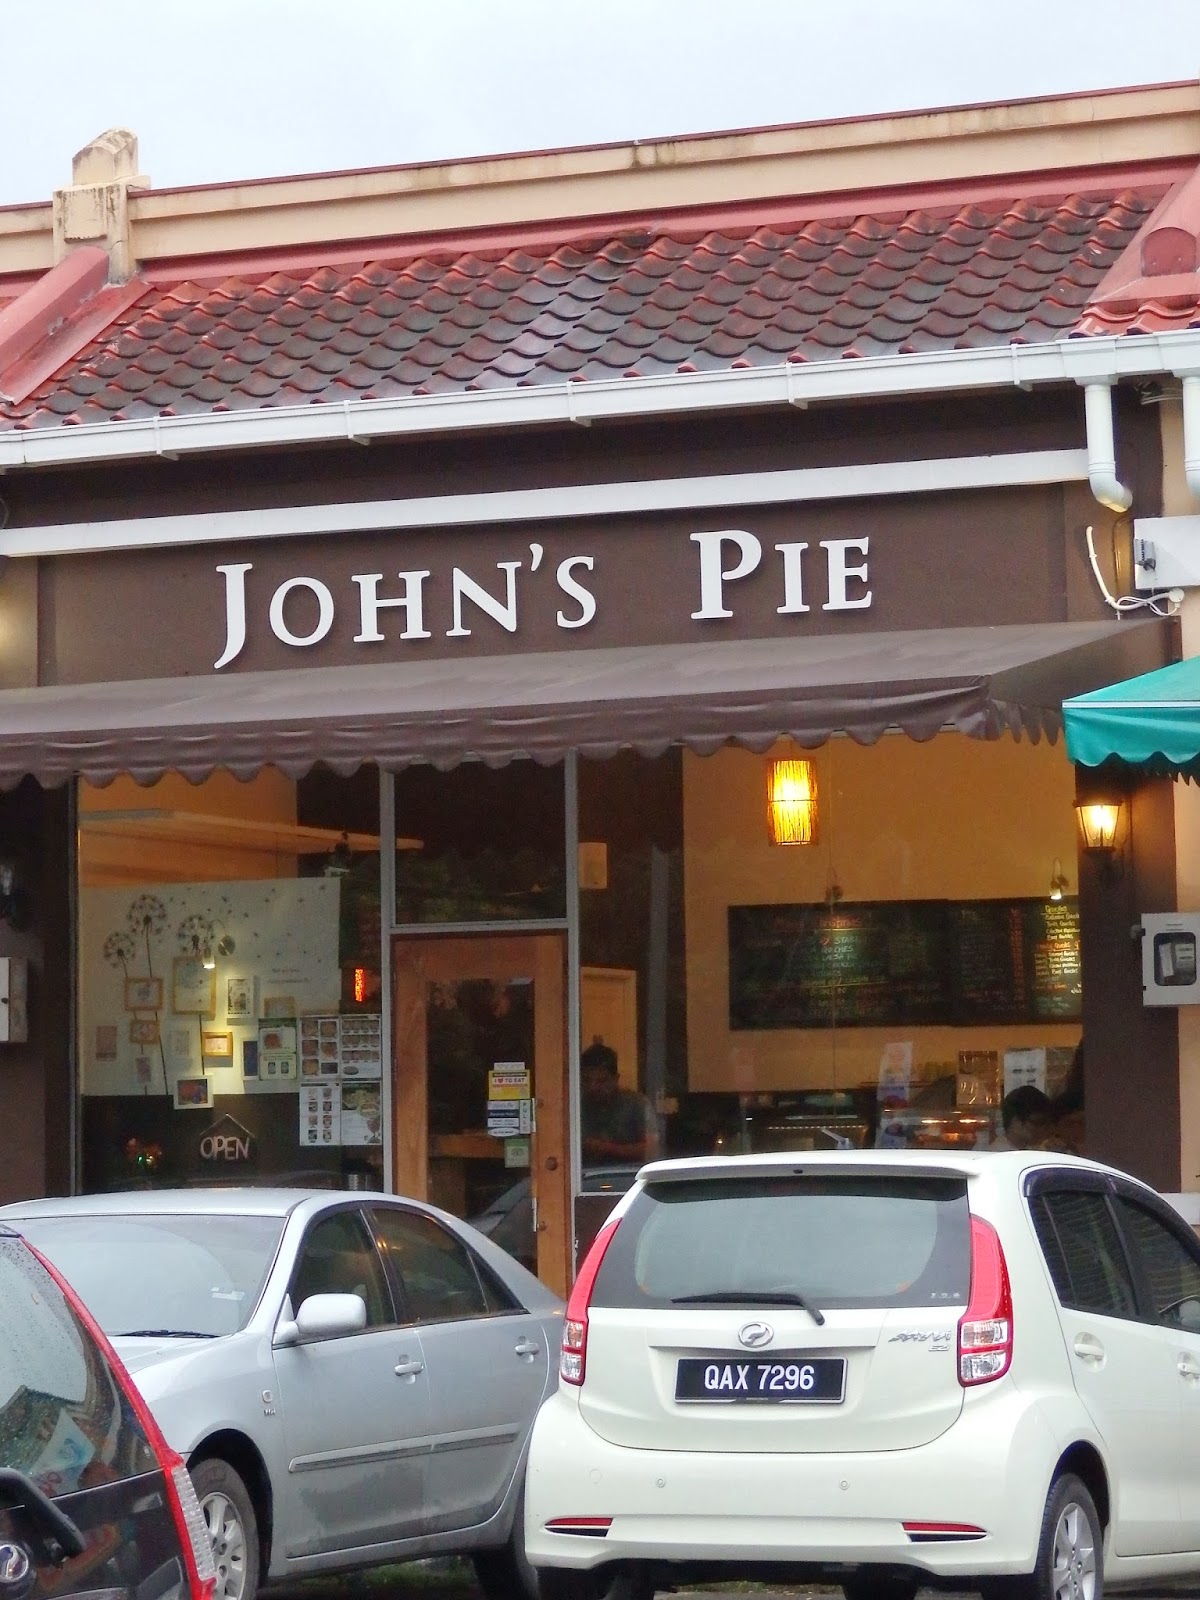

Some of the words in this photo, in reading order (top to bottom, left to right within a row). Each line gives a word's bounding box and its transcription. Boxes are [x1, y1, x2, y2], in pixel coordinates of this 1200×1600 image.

[213, 543, 596, 669] JOHN'S
[689, 529, 873, 620] PIE
[200, 1135, 250, 1160] OPEN
[704, 1364, 750, 1390] QAX
[757, 1364, 815, 1390] 7296
